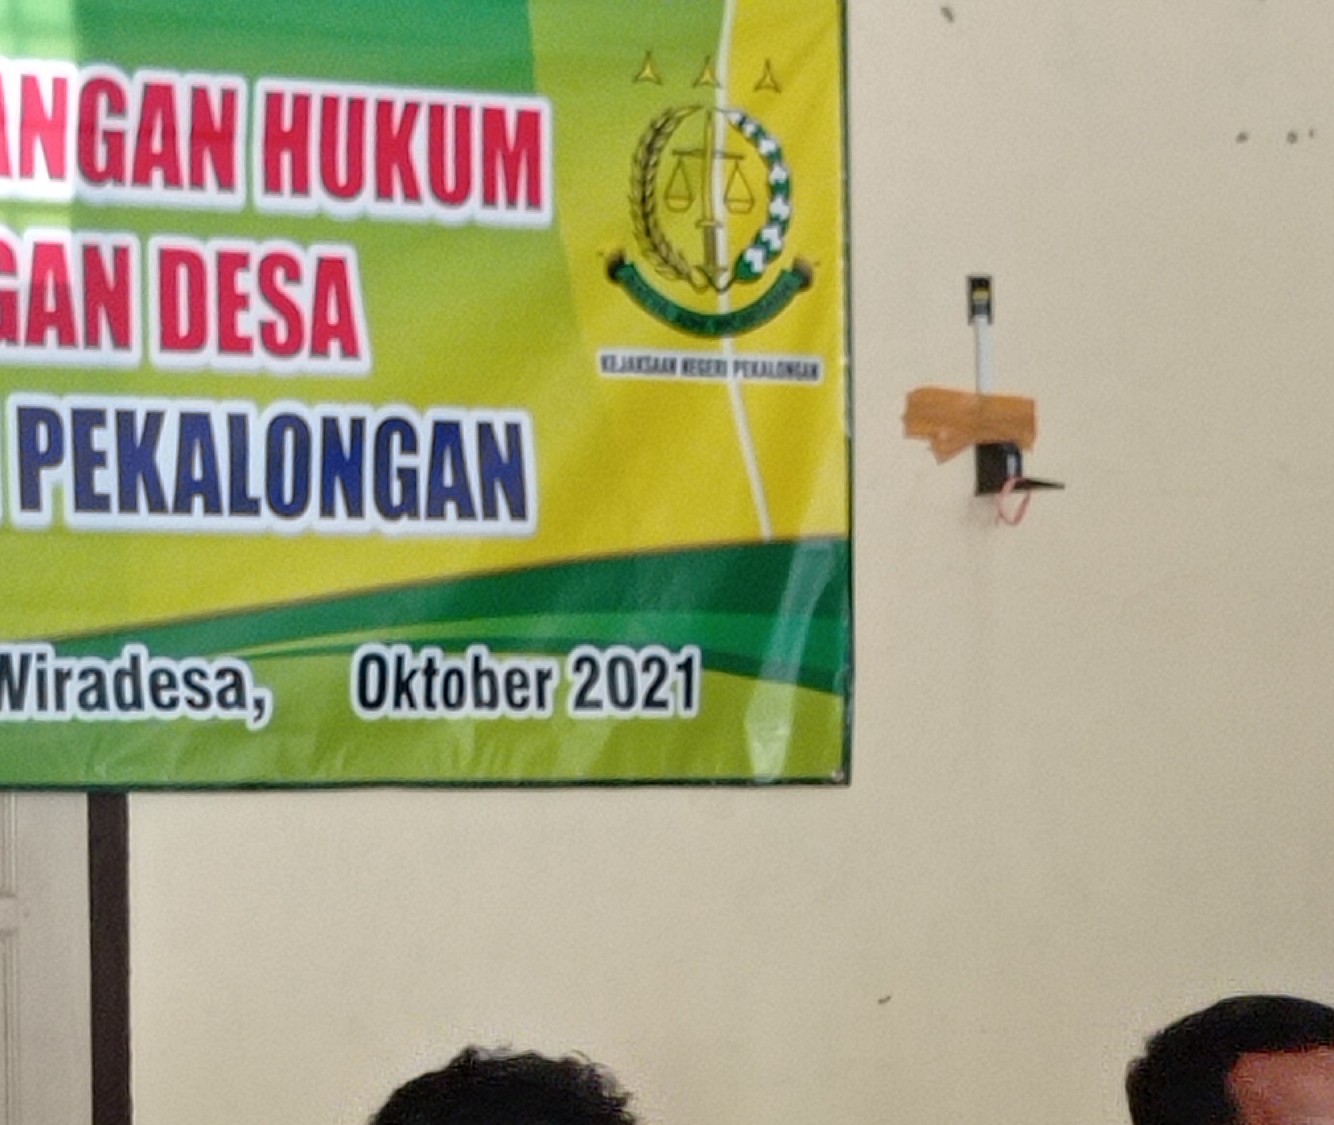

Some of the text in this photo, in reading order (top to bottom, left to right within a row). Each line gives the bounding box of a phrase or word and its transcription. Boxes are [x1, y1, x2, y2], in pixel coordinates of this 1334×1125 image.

[267, 91, 544, 210] HUKUM
[159, 246, 361, 360] DESA
[601, 355, 819, 380] KEJAKSAAN NEGERI PEKALONGAN
[16, 409, 527, 523] PEKALONGAN
[356, 652, 553, 711] Oktober
[572, 650, 701, 711] 2021
